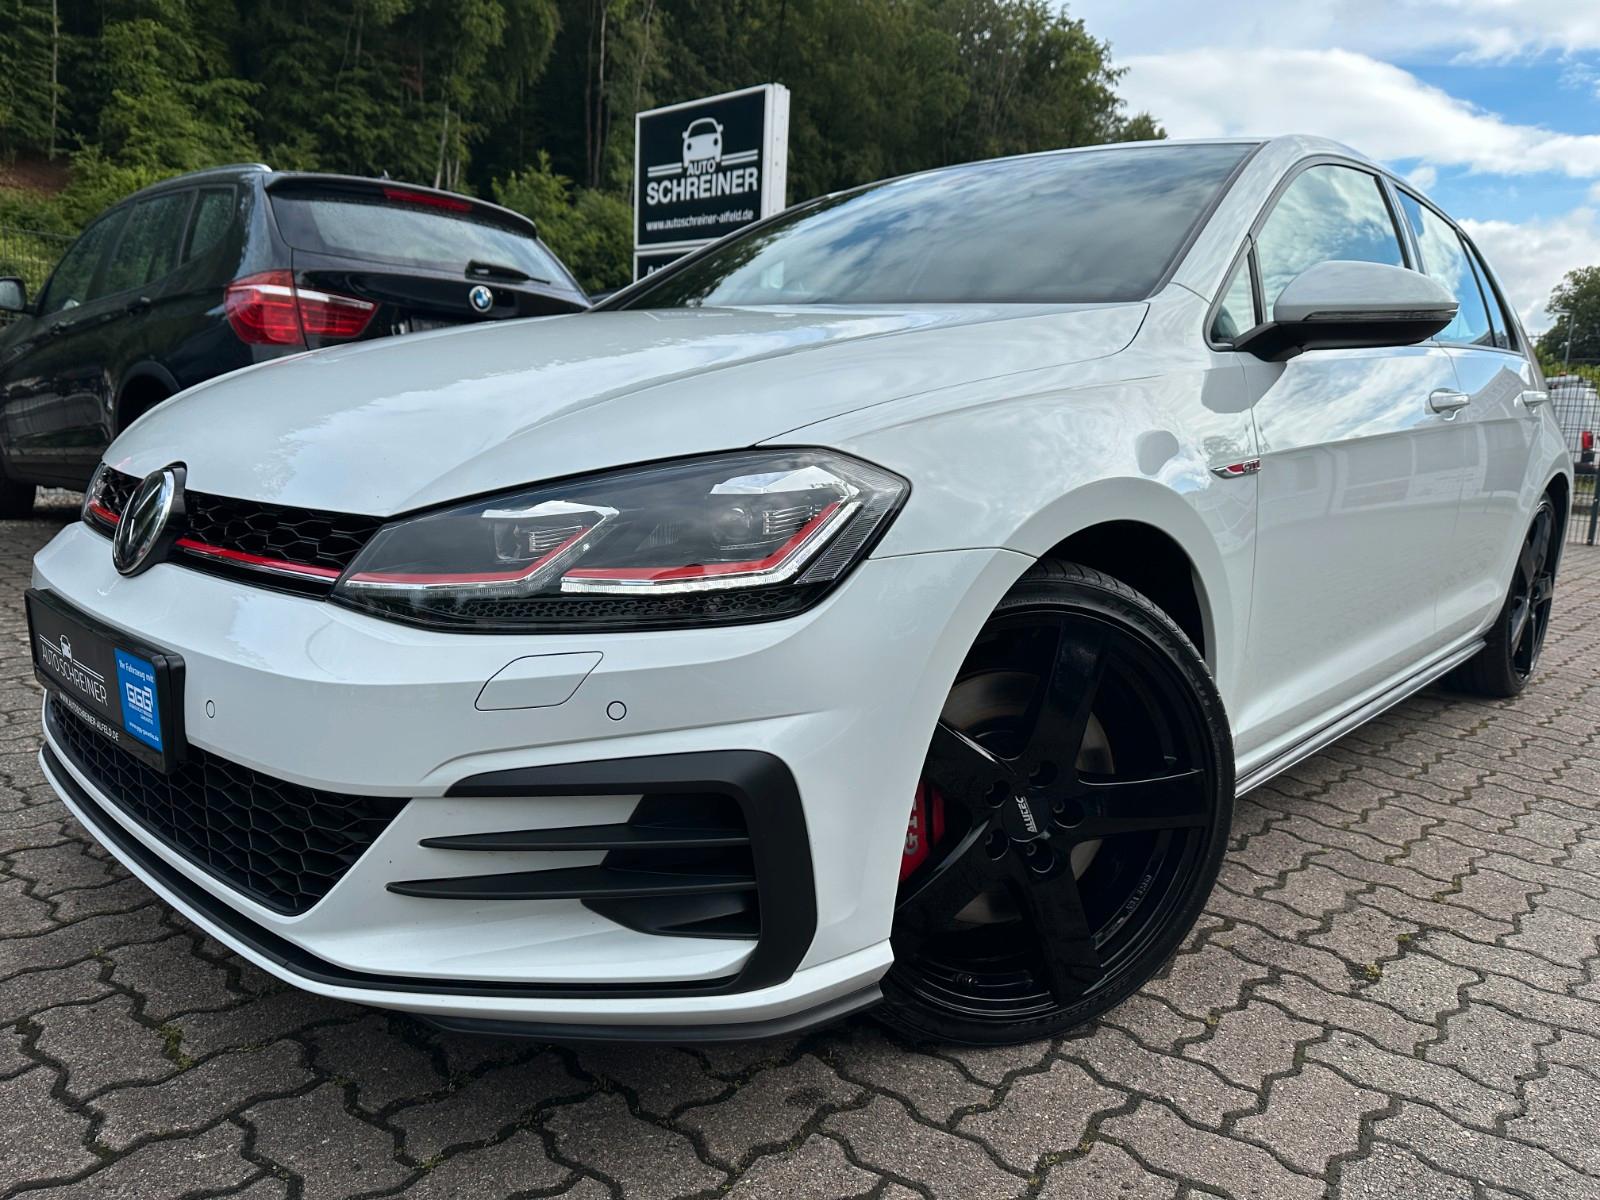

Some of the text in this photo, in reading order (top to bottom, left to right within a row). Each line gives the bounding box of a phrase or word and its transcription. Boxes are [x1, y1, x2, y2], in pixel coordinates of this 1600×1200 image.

[646, 166, 759, 206] SCHREINER
[686, 159, 717, 176] AUTO
[904, 798, 919, 856] GT
[1014, 795, 1037, 833] ALUTEC
